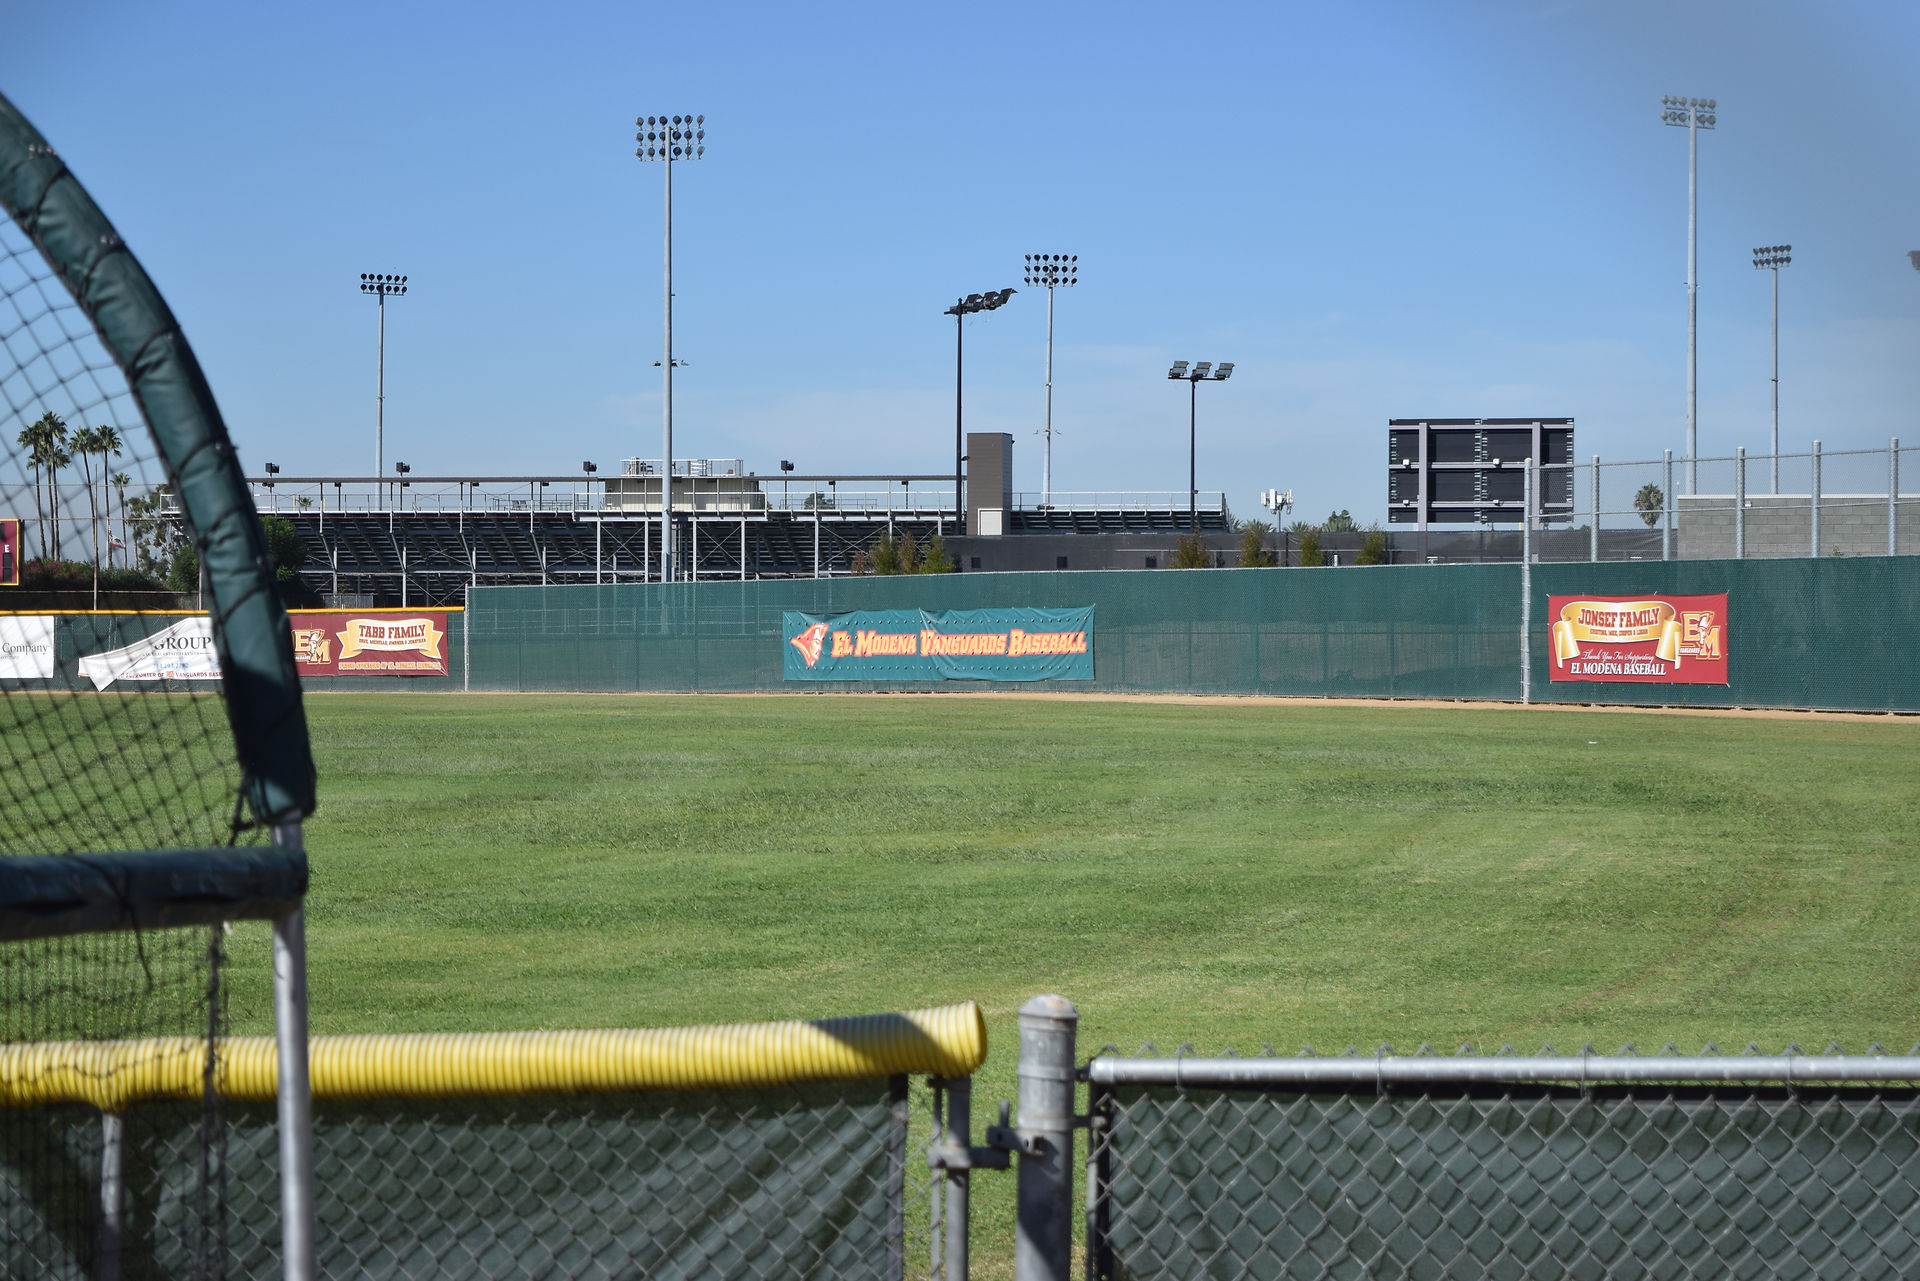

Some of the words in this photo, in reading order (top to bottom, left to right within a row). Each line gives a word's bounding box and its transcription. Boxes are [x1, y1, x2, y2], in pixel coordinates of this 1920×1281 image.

[4, 544, 10, 553] E
[1578, 608, 1618, 628] JONSEF
[1619, 607, 1660, 628] FAMILY
[358, 624, 385, 638] TABB
[388, 624, 426, 639] FAMILY
[2, 642, 47, 655] Company
[1570, 663, 1582, 675] EL
[1583, 663, 1622, 675] MODENA
[1623, 663, 1666, 676] BASEBALL
